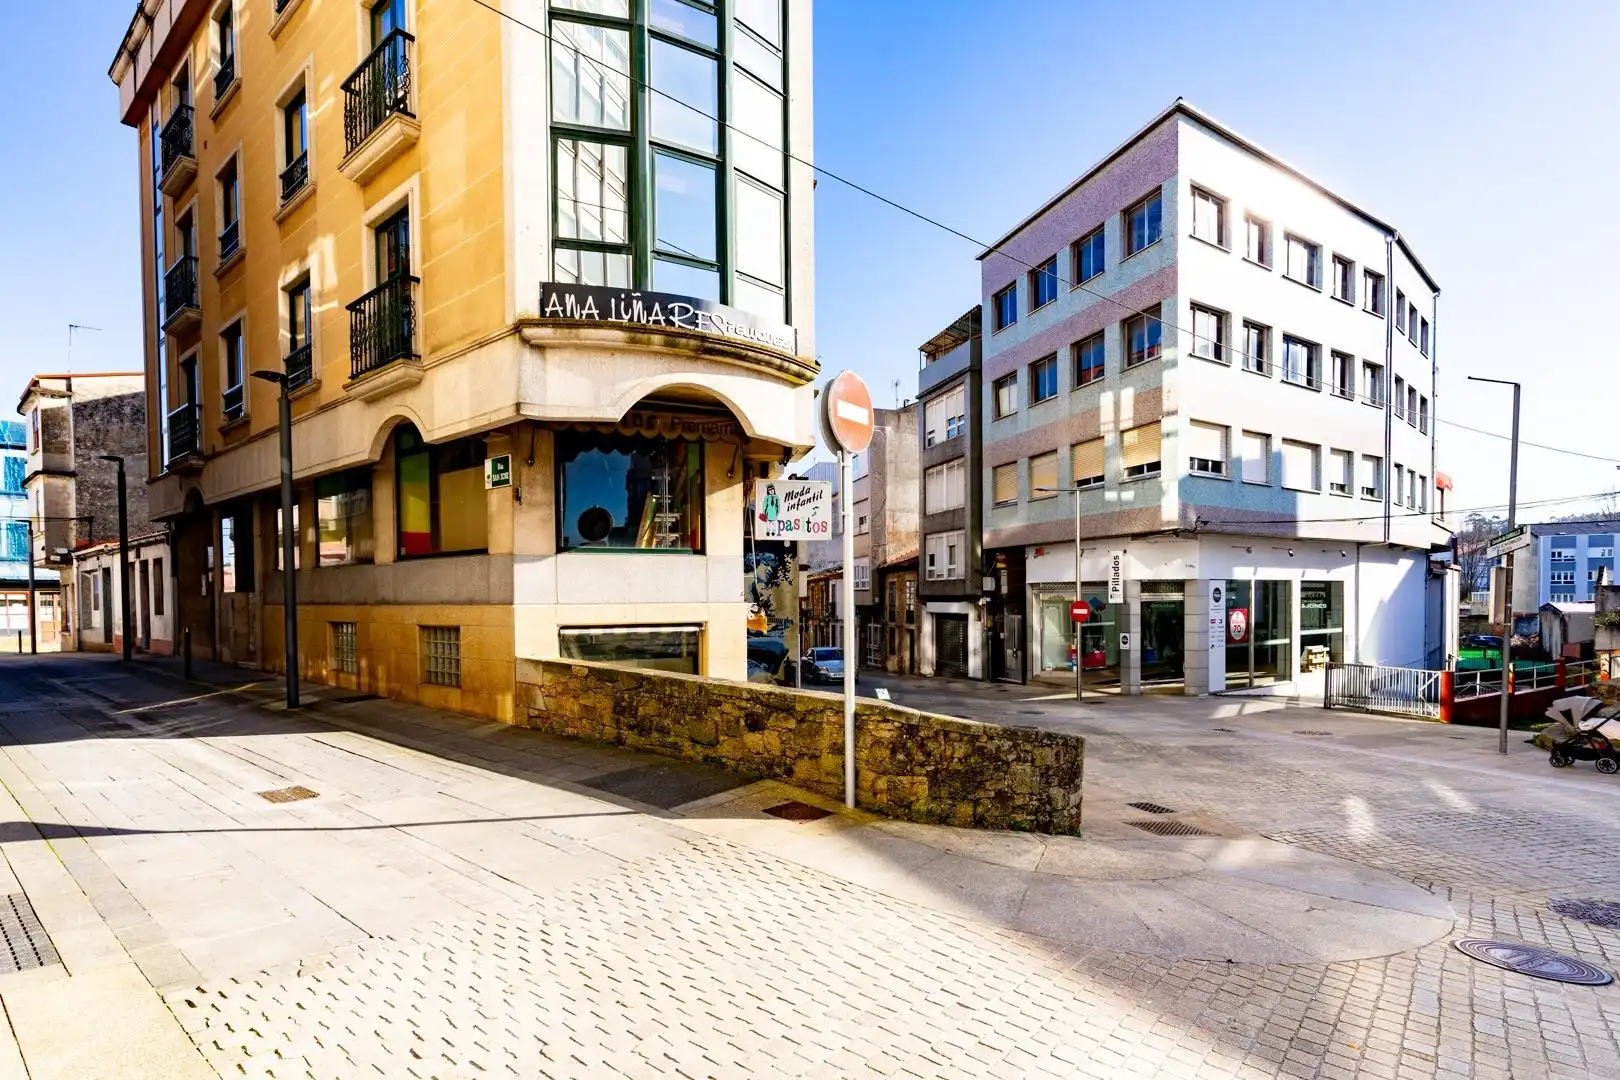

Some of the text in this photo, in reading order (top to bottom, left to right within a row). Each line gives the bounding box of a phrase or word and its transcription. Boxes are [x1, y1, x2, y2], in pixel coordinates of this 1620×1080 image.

[544, 291, 600, 320] ANA
[784, 485, 811, 503] Moda
[786, 489, 823, 512] infantil
[776, 516, 828, 537] pasitos
[1111, 554, 1120, 592] Pillados
